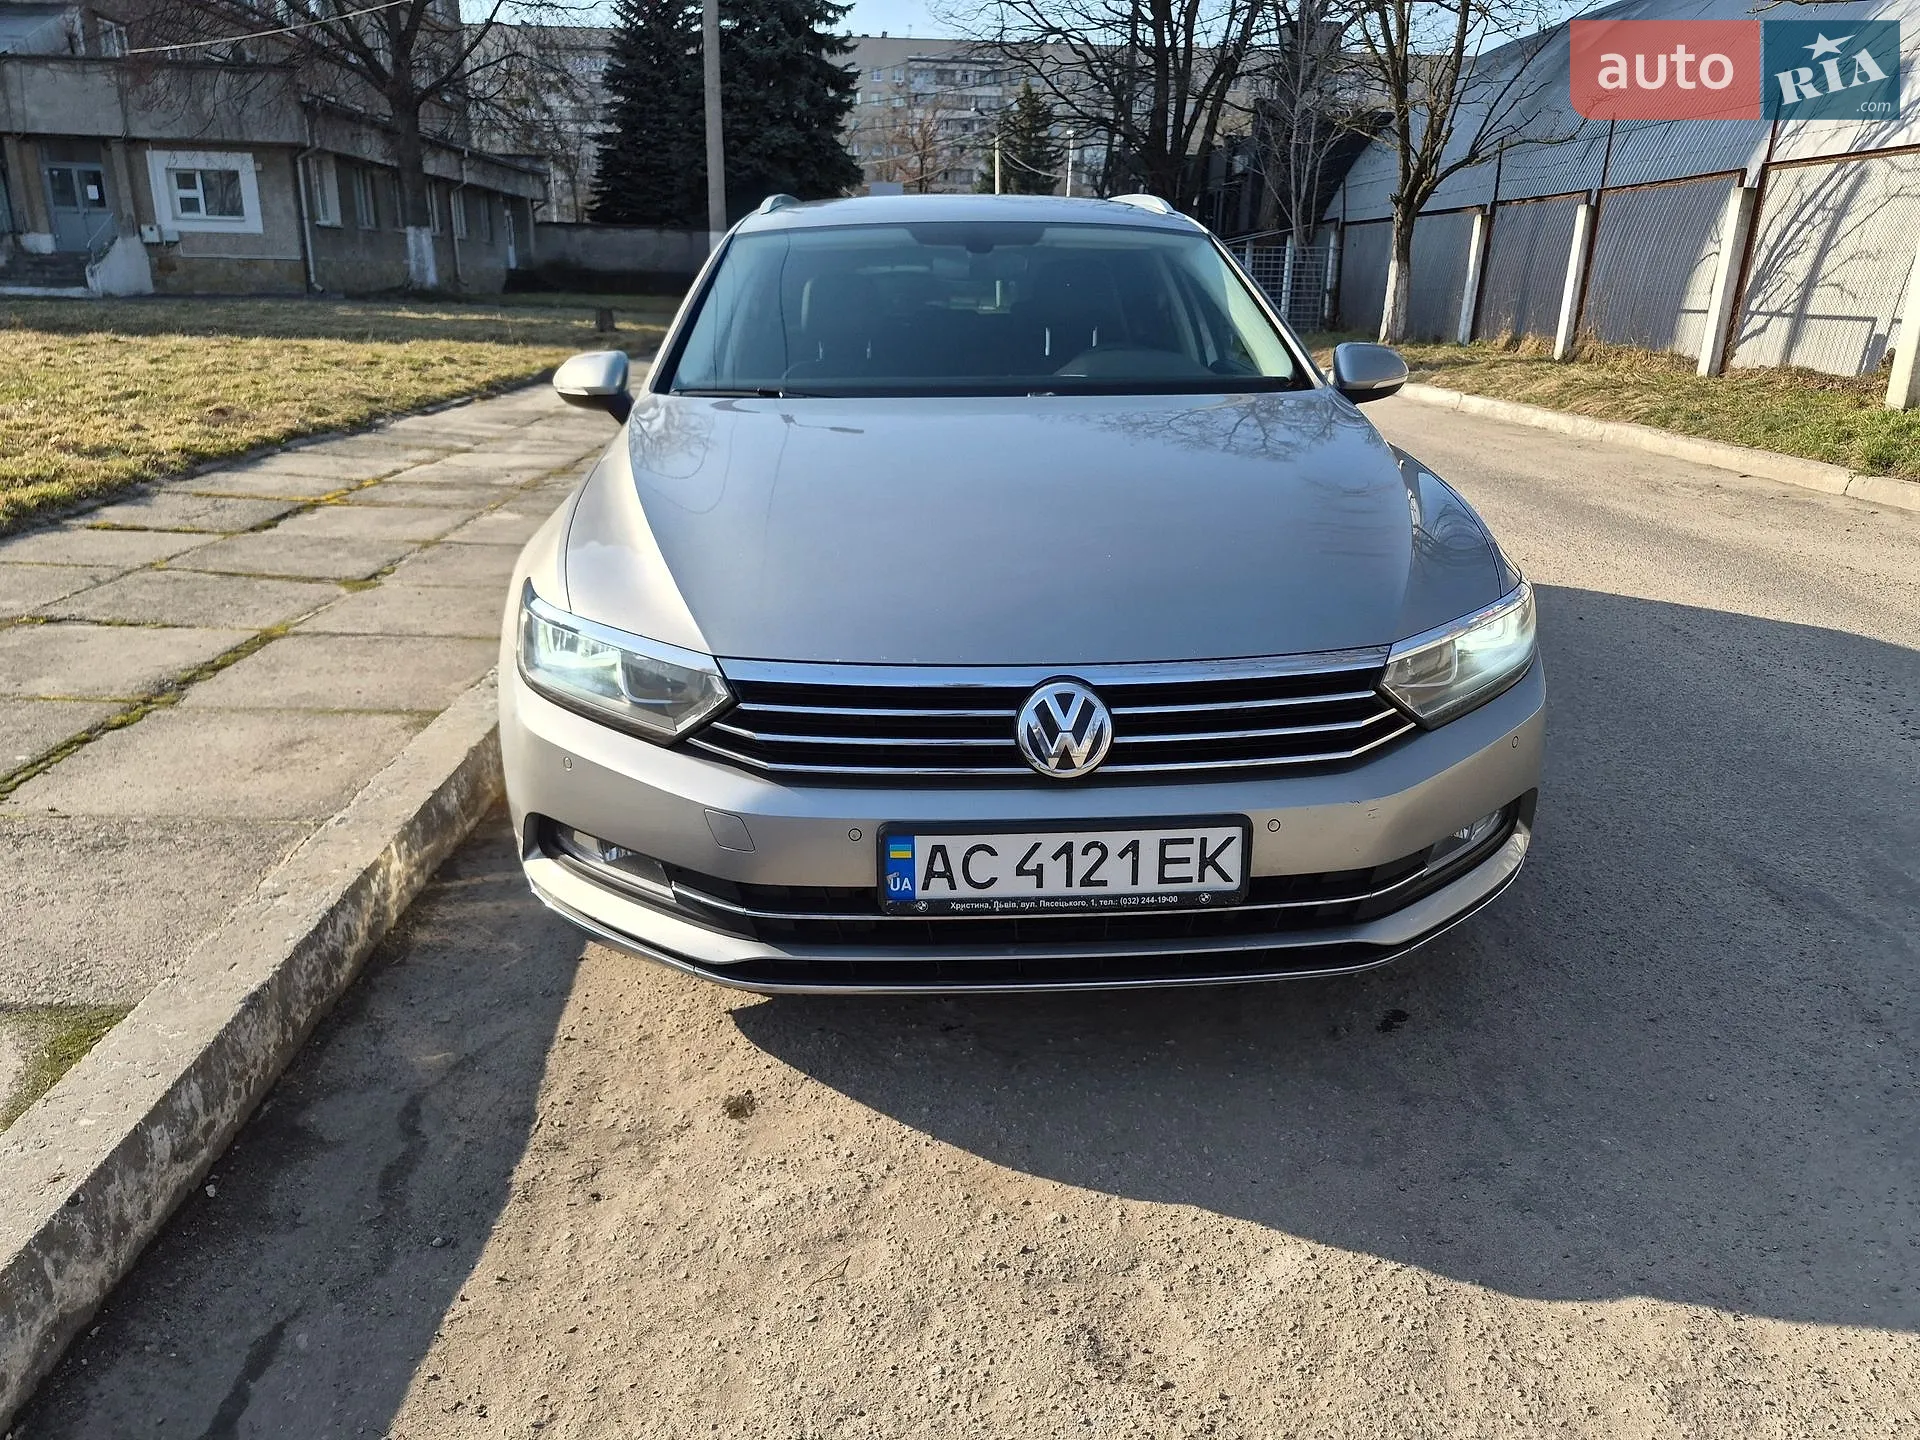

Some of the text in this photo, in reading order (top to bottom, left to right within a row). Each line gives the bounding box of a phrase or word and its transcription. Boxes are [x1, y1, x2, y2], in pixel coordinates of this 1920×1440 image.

[921, 835, 1237, 891] AC 4121 EK
[890, 877, 913, 891] UA
[1120, 896, 1139, 906] (032)
